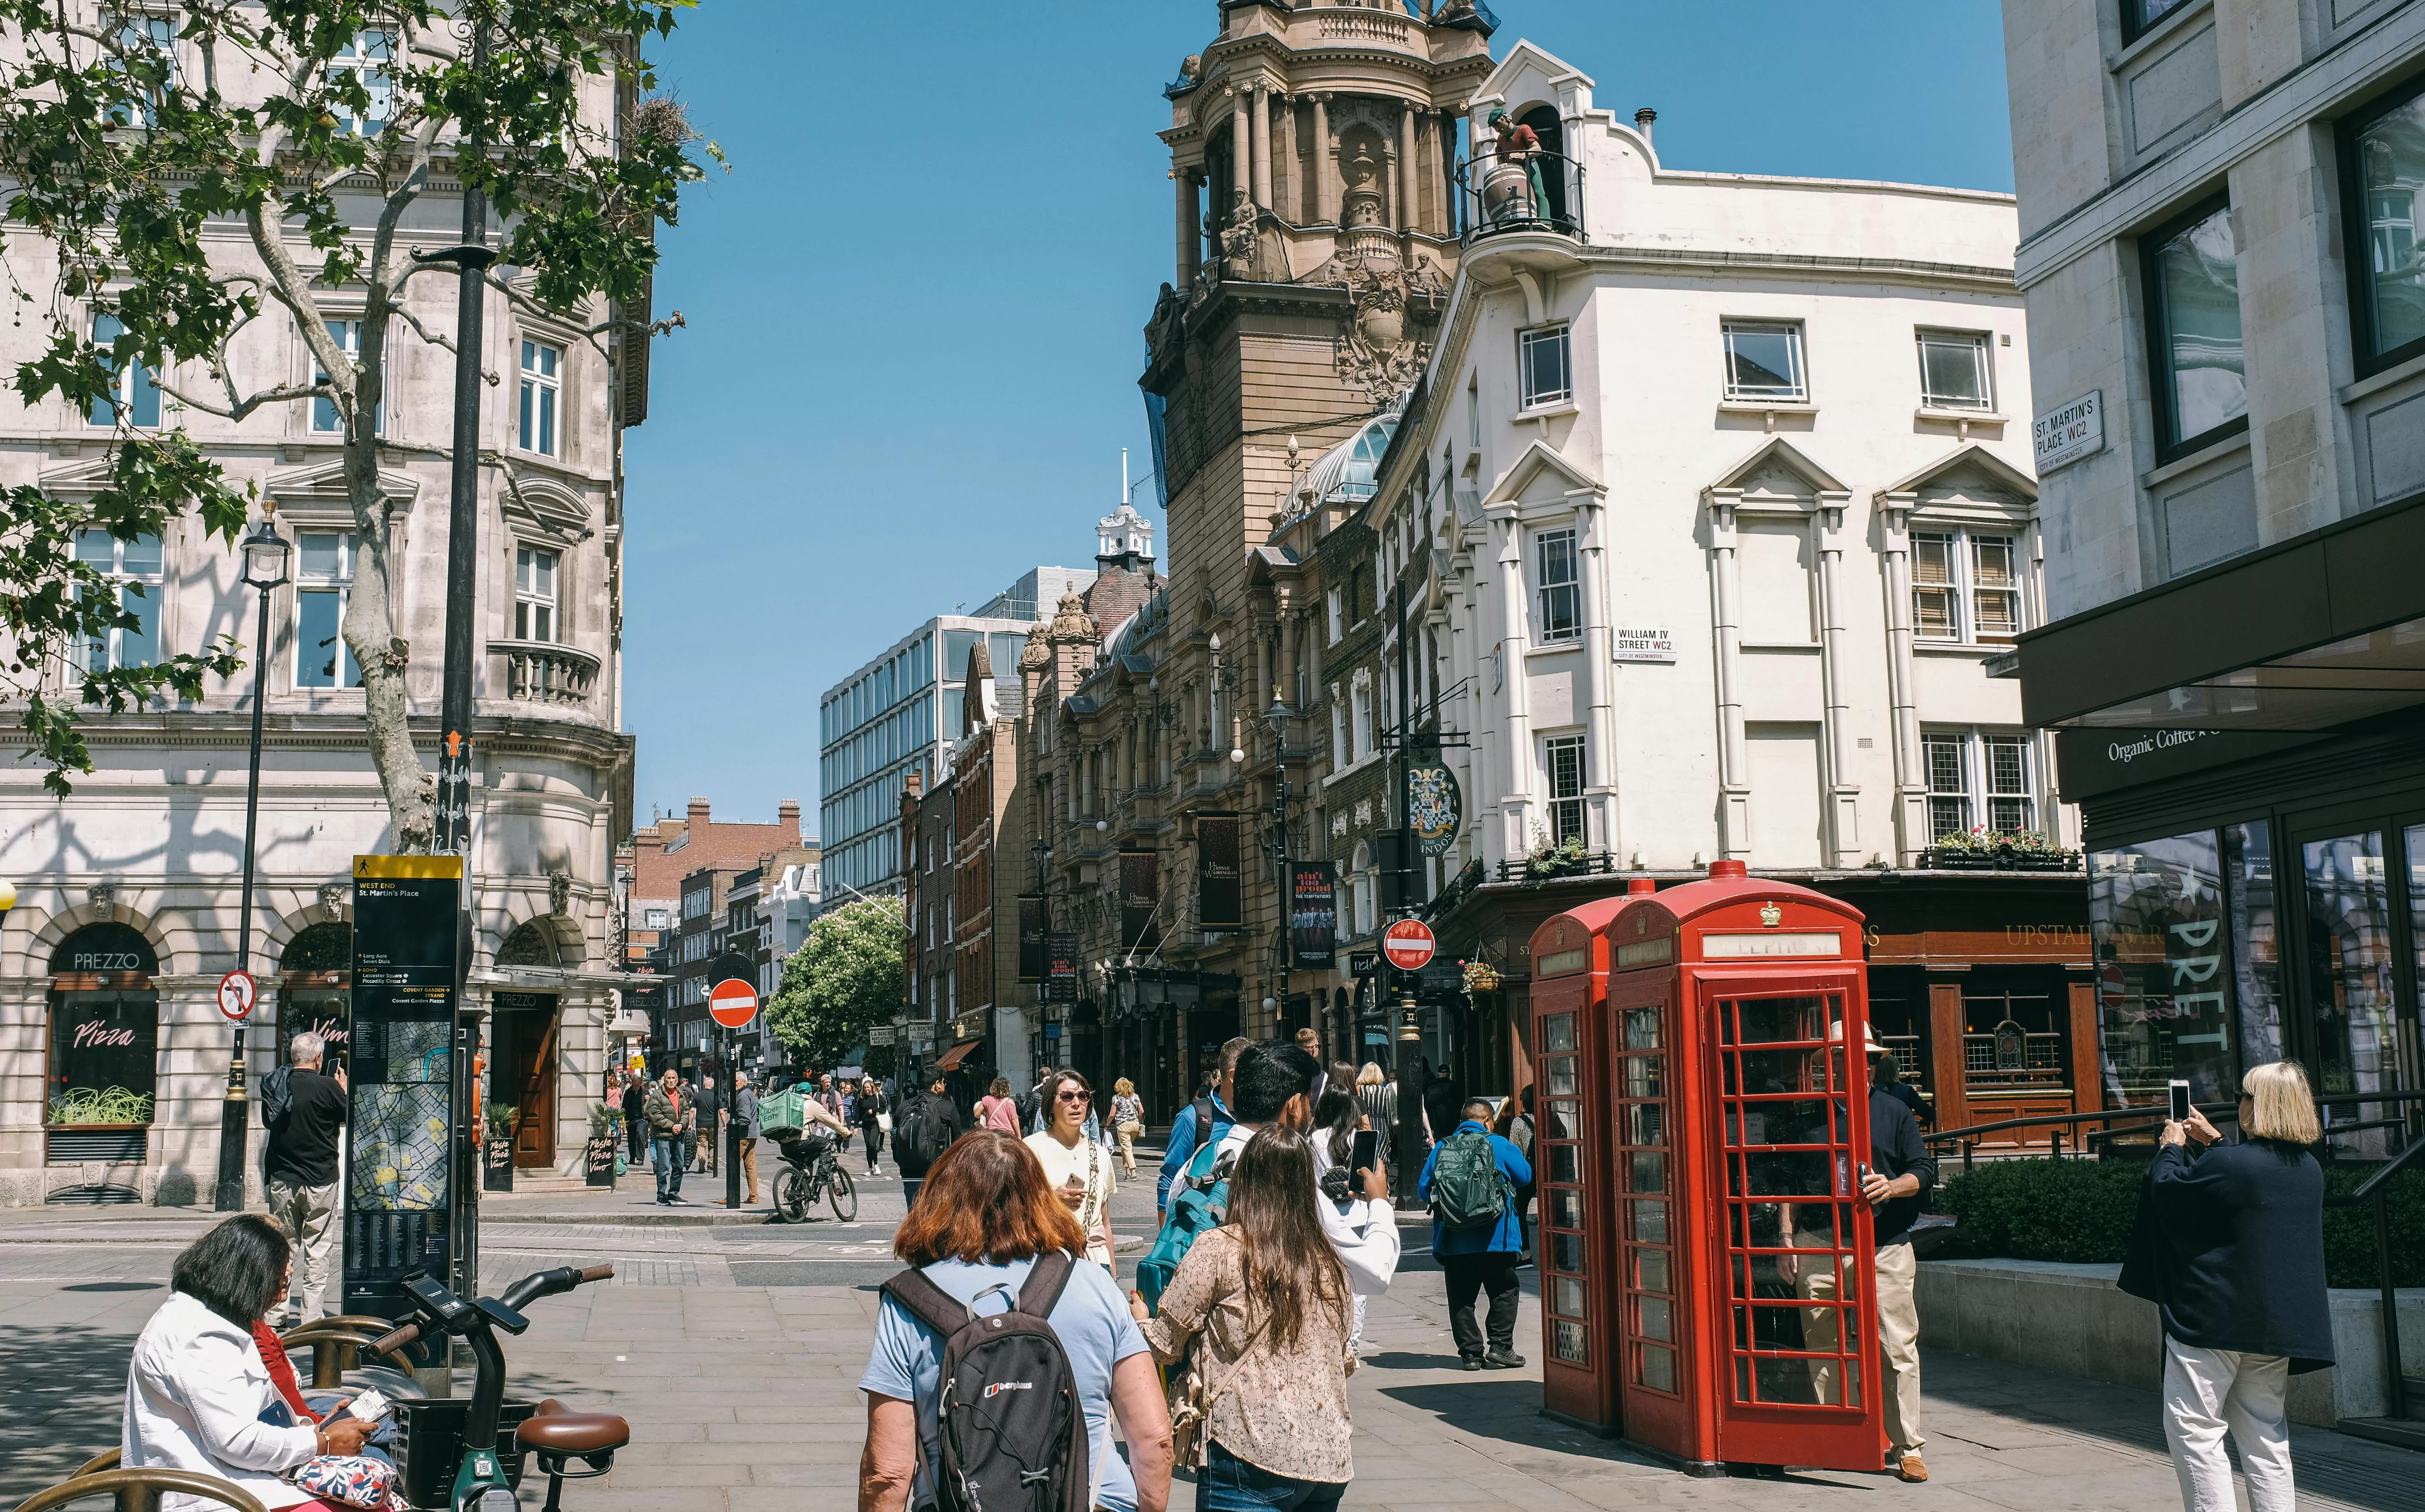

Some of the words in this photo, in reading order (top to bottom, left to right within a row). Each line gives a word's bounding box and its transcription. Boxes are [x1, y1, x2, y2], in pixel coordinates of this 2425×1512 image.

[2036, 421, 2048, 438] ST.
[2050, 399, 2093, 431] MARTIN'S
[2038, 431, 2063, 456] PLACE
[2067, 421, 2087, 441] WC2
[2040, 463, 2048, 471] CITY
[2054, 447, 2082, 464] WESTMINSTER
[1618, 629, 1656, 639] WILLIAM
[1660, 631, 1668, 639] IV
[1618, 640, 1650, 649] STREET
[1653, 641, 1672, 649] WC2
[2108, 734, 2154, 762] Organic
[1210, 861, 1230, 870] HANNAH
[1297, 871, 1322, 880] ain't
[1296, 884, 1331, 894] proud
[2119, 925, 2166, 945] BAR
[75, 953, 139, 969] PREZZO
[2170, 919, 2228, 1051] PRET
[502, 994, 536, 1007] PREZZO
[625, 997, 660, 1006] PREZZO
[74, 1020, 135, 1048] Pizza
[313, 1018, 349, 1043] Vin
[764, 1106, 779, 1115] Uber
[764, 1113, 779, 1122] Eats
[490, 1141, 509, 1150] Pasta
[589, 1138, 612, 1150] Pasta
[490, 1149, 509, 1159] Pizza
[589, 1149, 612, 1161] Pizza
[490, 1159, 508, 1169] Vino
[589, 1162, 611, 1173] Vino
[999, 1381, 1032, 1390] berghaus
